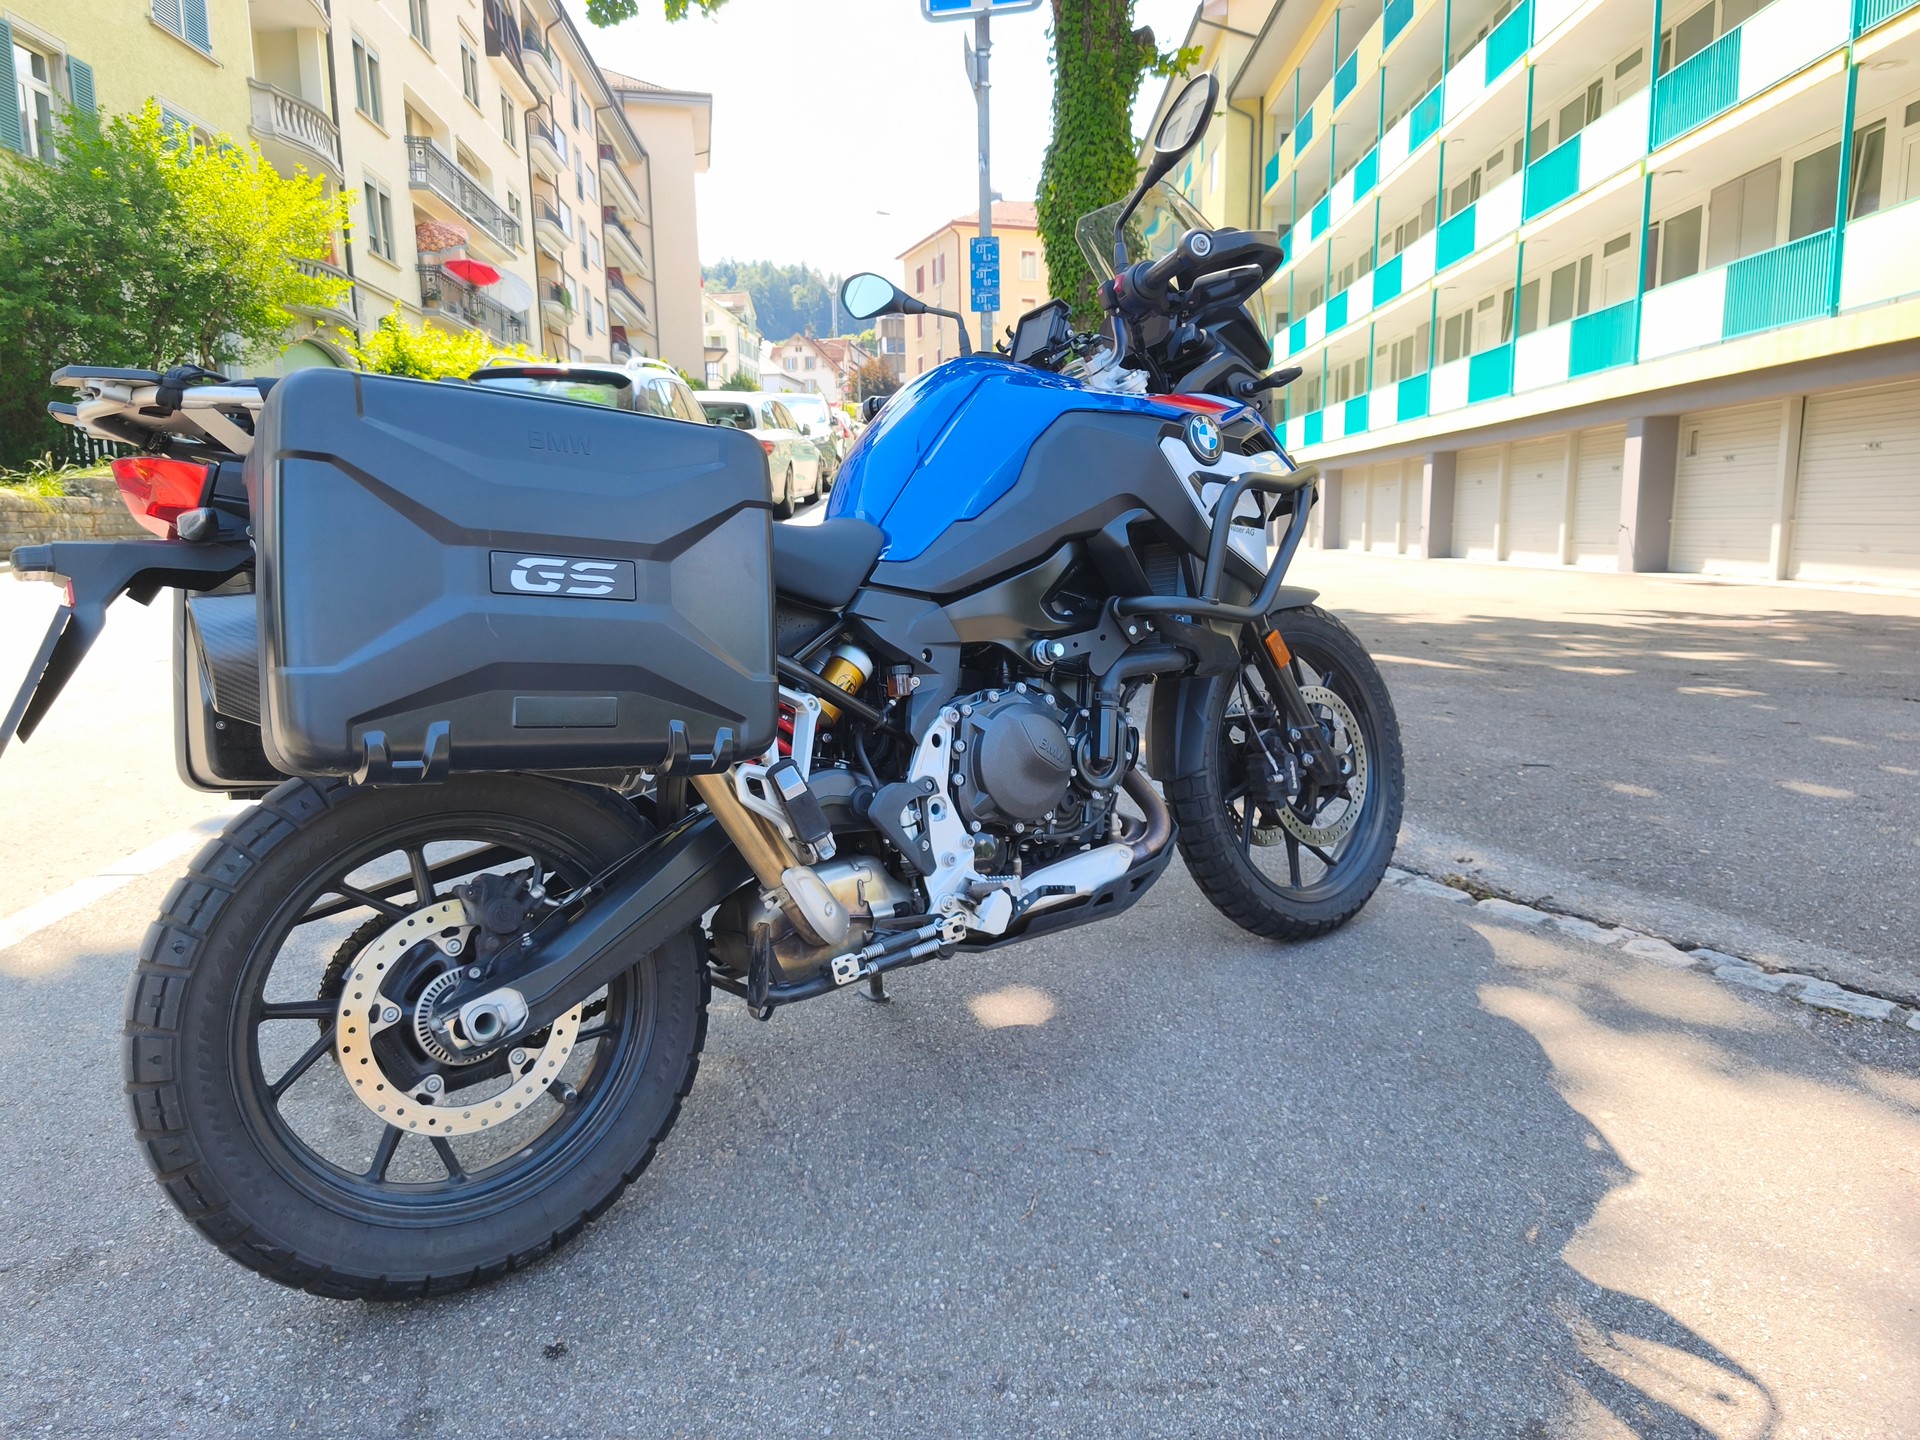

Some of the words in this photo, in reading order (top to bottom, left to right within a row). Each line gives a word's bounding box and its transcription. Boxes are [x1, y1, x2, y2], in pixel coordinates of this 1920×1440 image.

[1194, 416, 1219, 432] BMW
[528, 429, 593, 456] BMW
[1245, 527, 1256, 537] AG
[510, 557, 618, 595] GS
[1038, 738, 1066, 763] BMW
